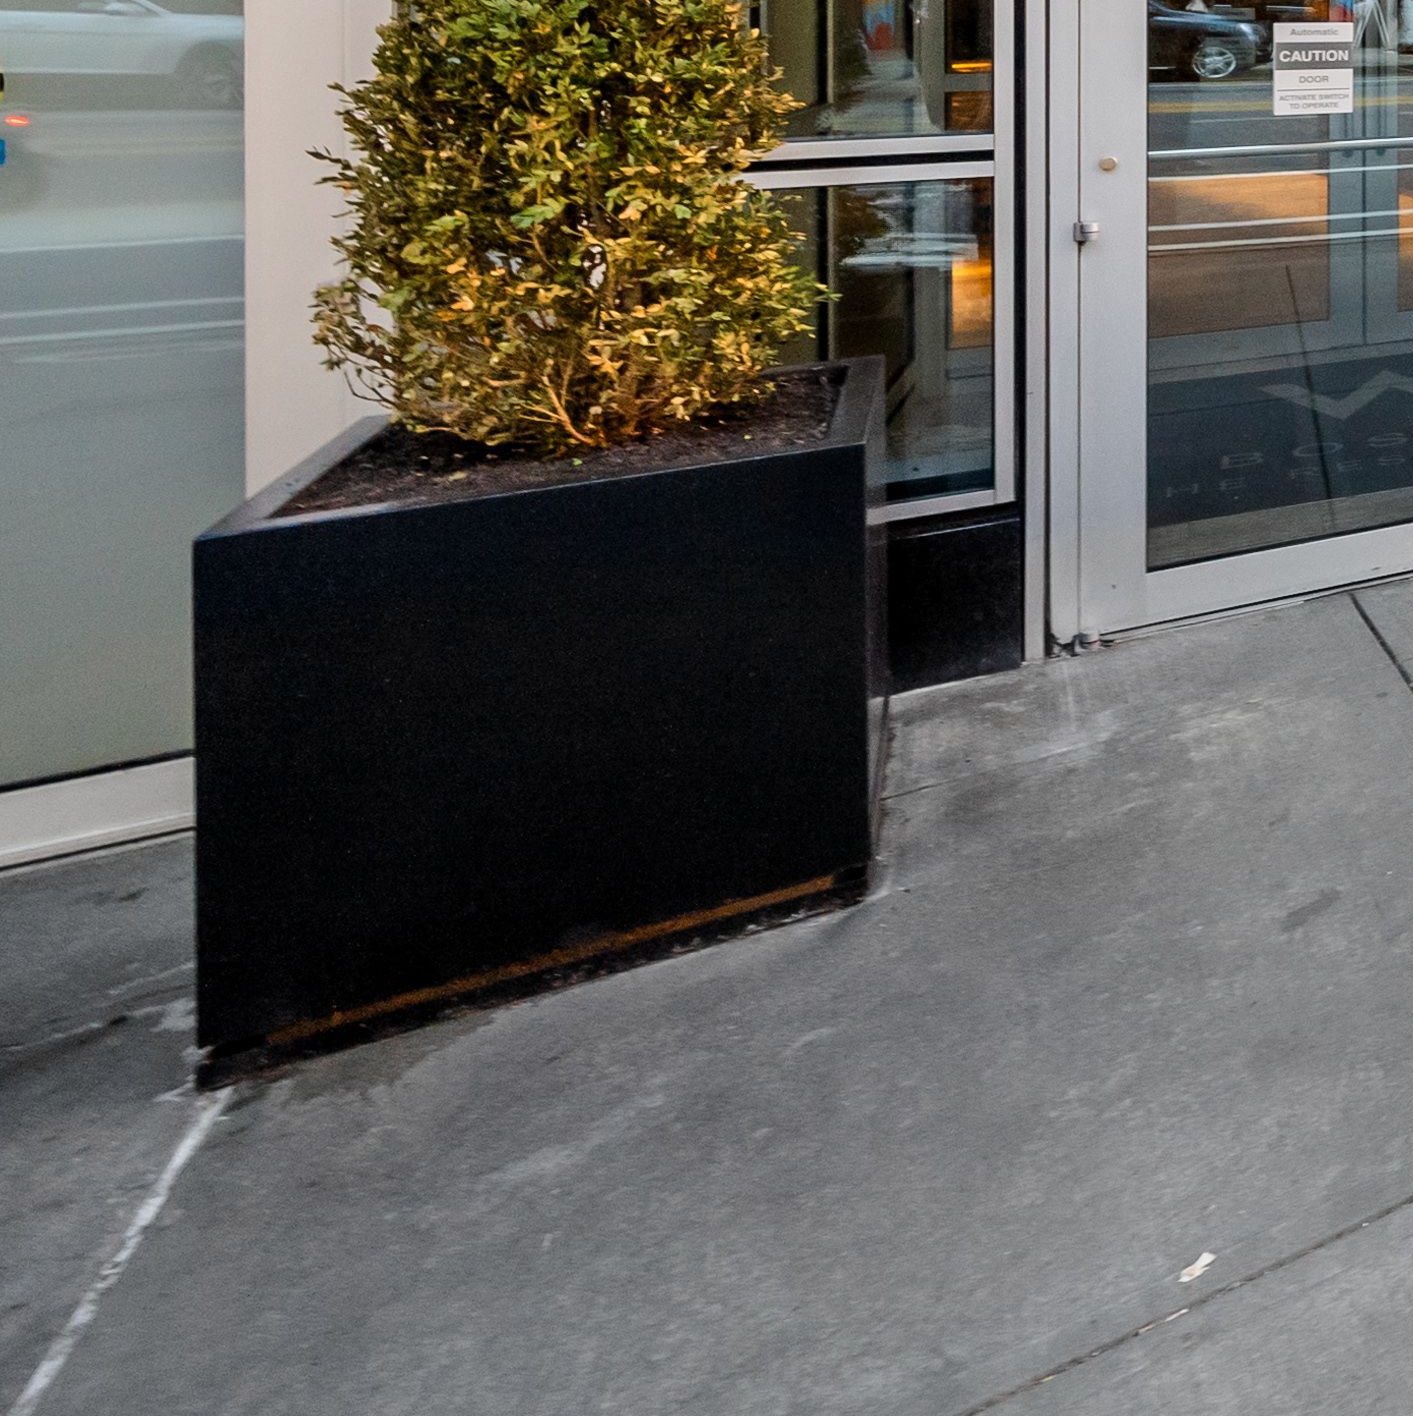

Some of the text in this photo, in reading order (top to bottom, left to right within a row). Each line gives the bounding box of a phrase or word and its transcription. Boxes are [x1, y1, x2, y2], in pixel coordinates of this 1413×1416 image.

[1289, 28, 1339, 37] Automatic
[1279, 49, 1349, 62] CAUTION
[1298, 75, 1329, 84] DOOR
[1279, 93, 1349, 102] ACTIVATE SWITCH
[1289, 102, 1339, 110] TO OPERATE
